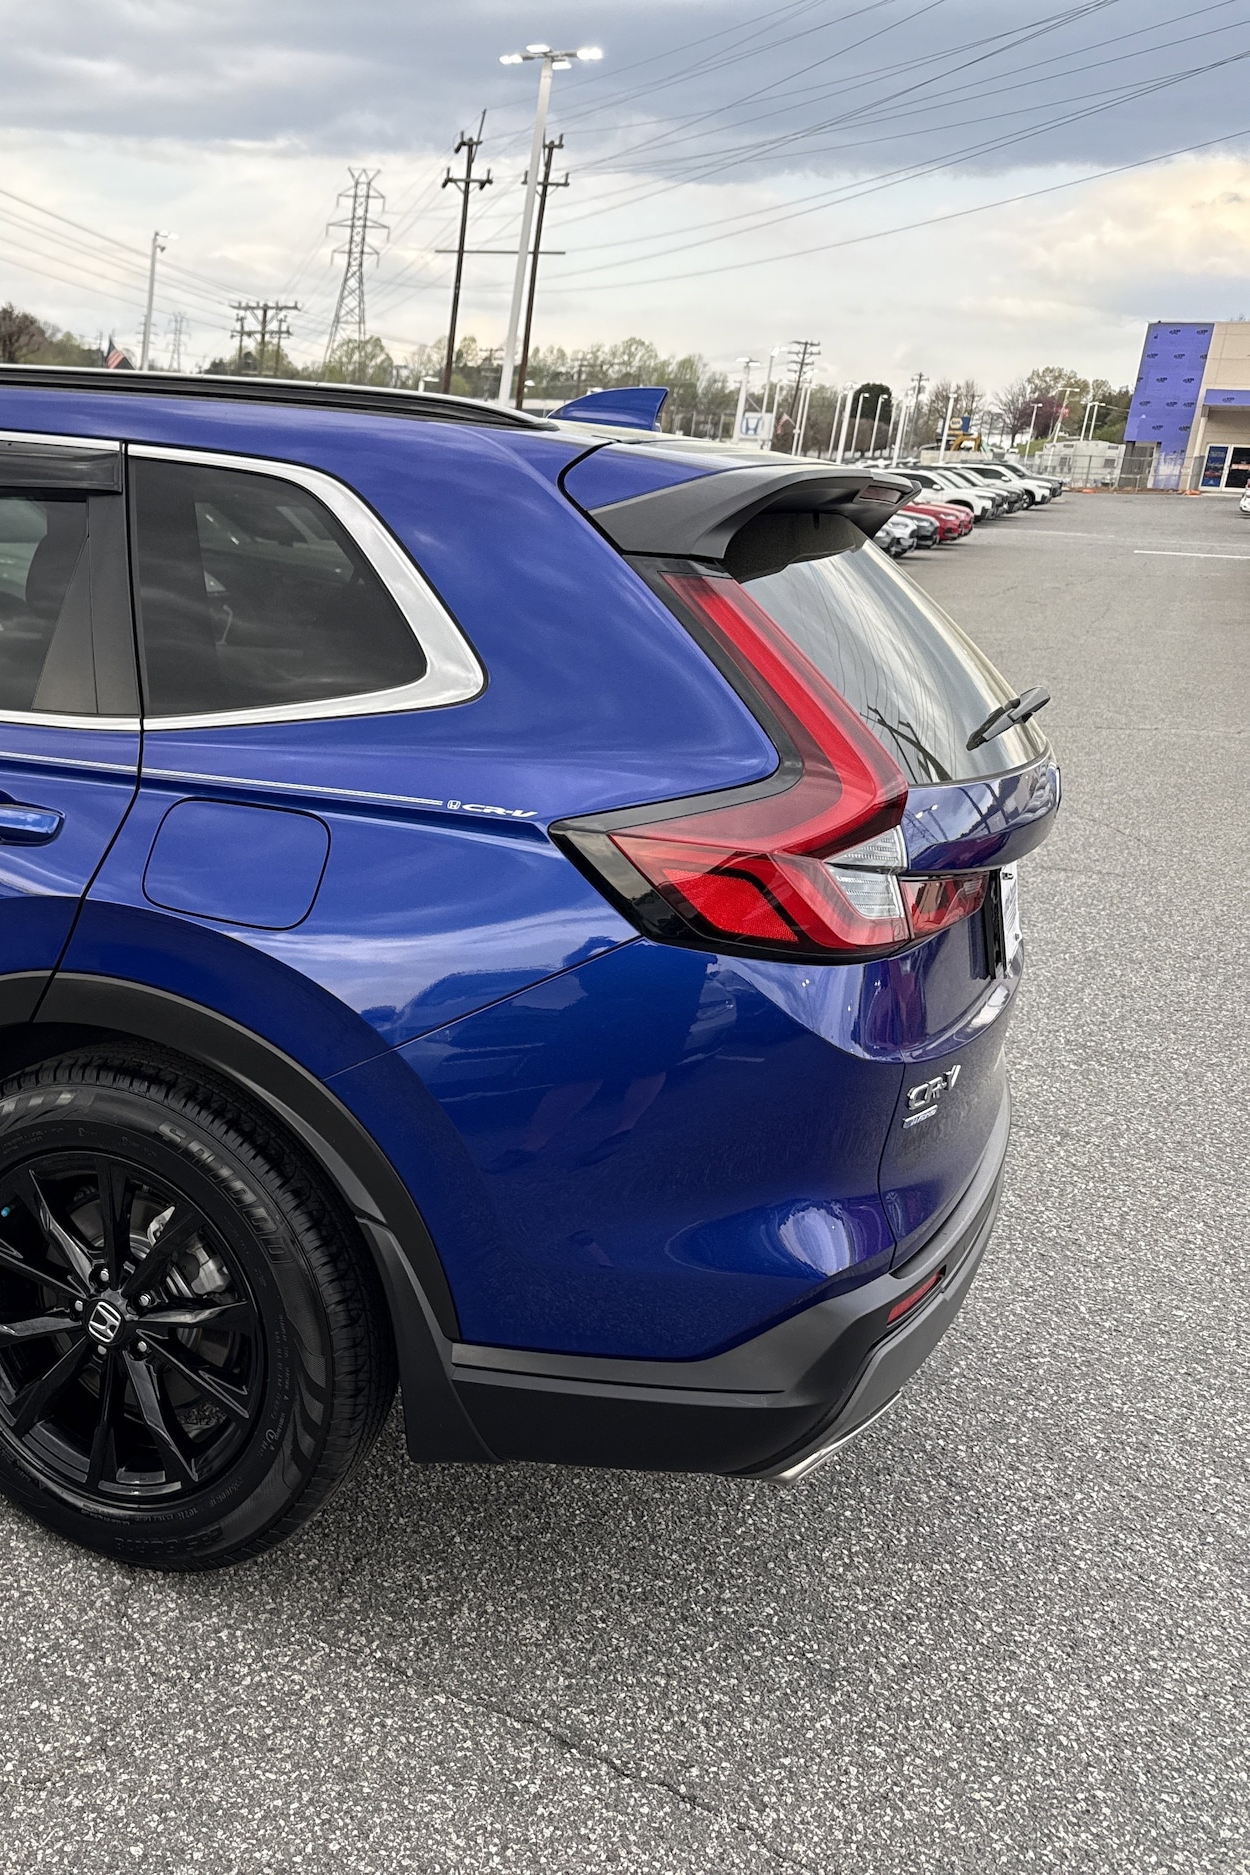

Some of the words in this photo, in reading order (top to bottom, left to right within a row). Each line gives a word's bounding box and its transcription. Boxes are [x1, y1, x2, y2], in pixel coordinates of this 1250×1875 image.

[462, 804, 538, 818] CR-V
[907, 1065, 961, 1110] CR-V
[158, 1120, 295, 1265] SA1000
